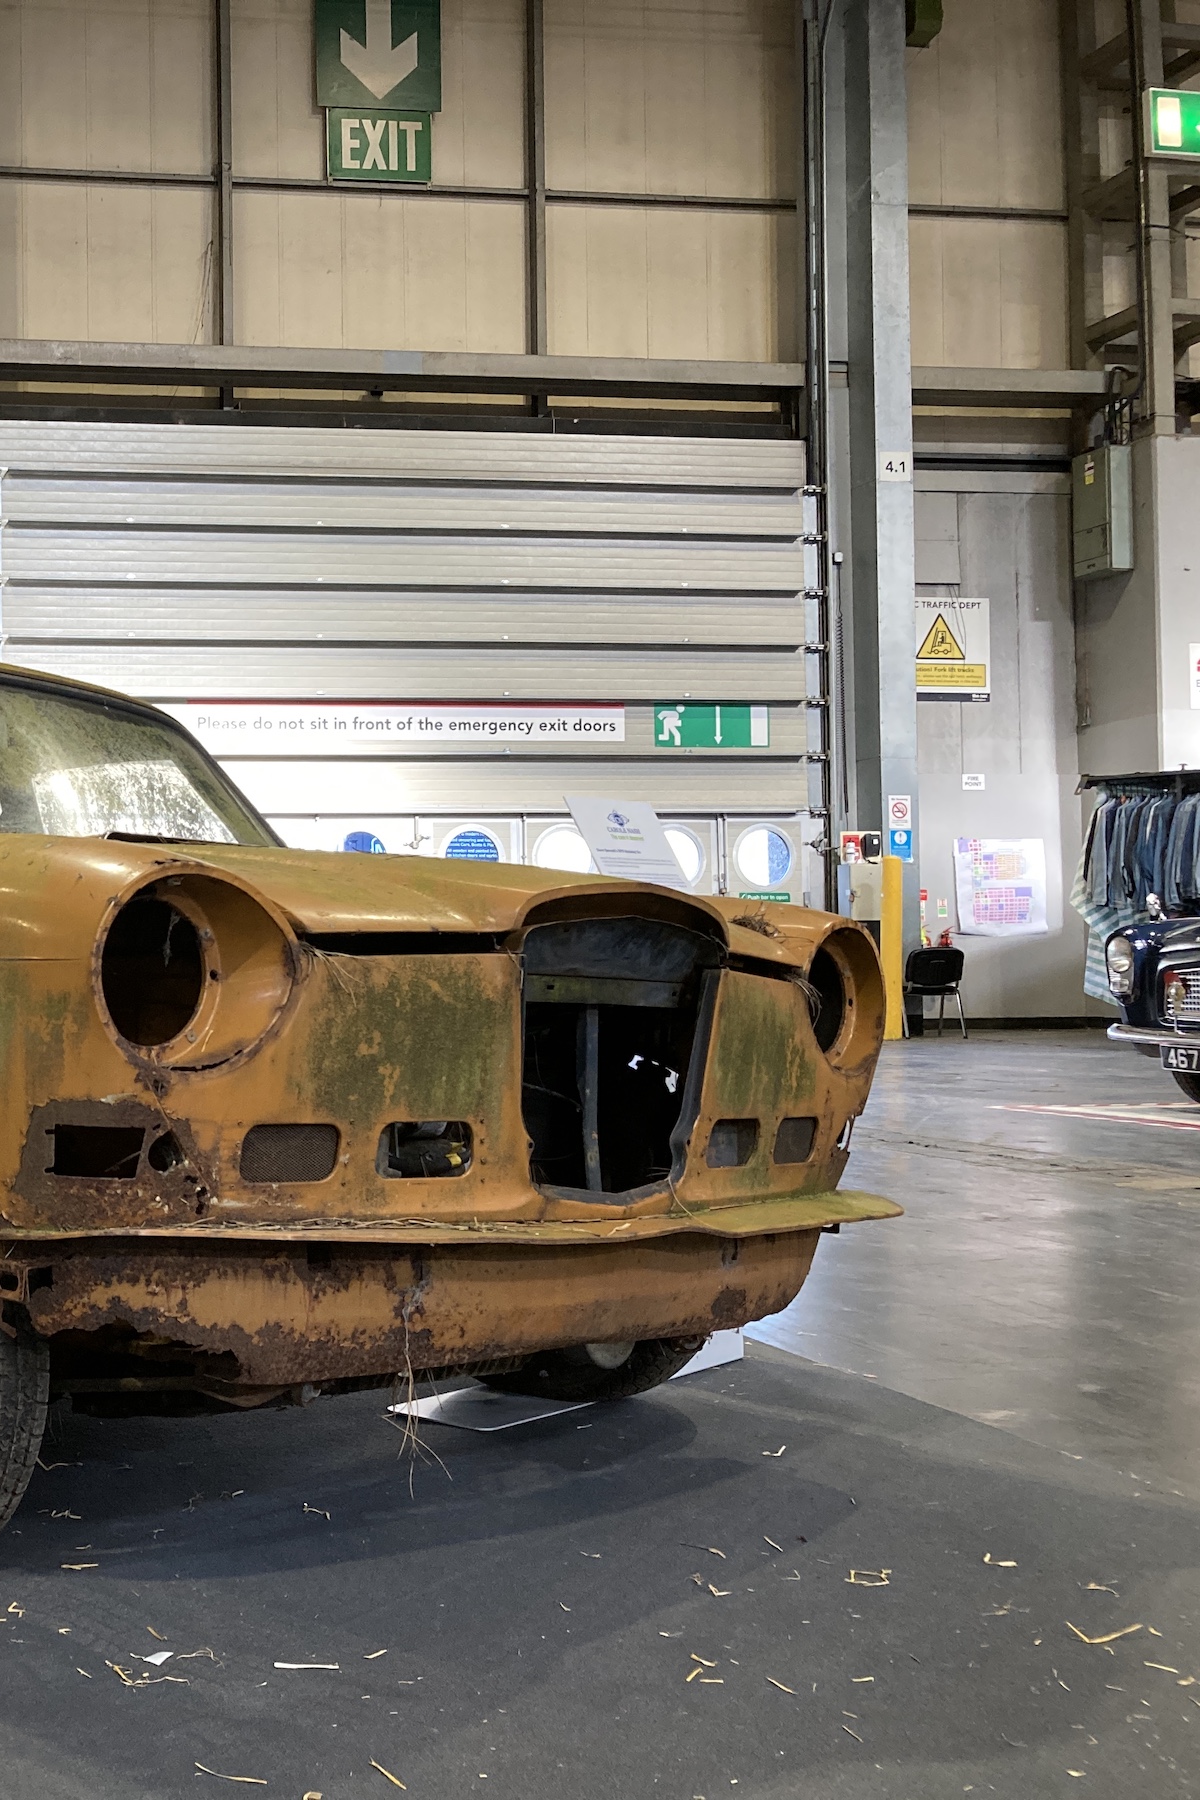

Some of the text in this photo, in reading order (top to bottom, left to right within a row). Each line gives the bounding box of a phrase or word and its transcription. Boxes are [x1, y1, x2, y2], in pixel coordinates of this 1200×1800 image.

[341, 118, 422, 171] EXIT
[885, 460, 905, 472] 4.1
[921, 601, 957, 609] TRAFFIC
[959, 602, 981, 610] DEPT
[197, 716, 616, 735] Please do not sit in front of the emergency exit doors
[1167, 1048, 1198, 1069] 467
